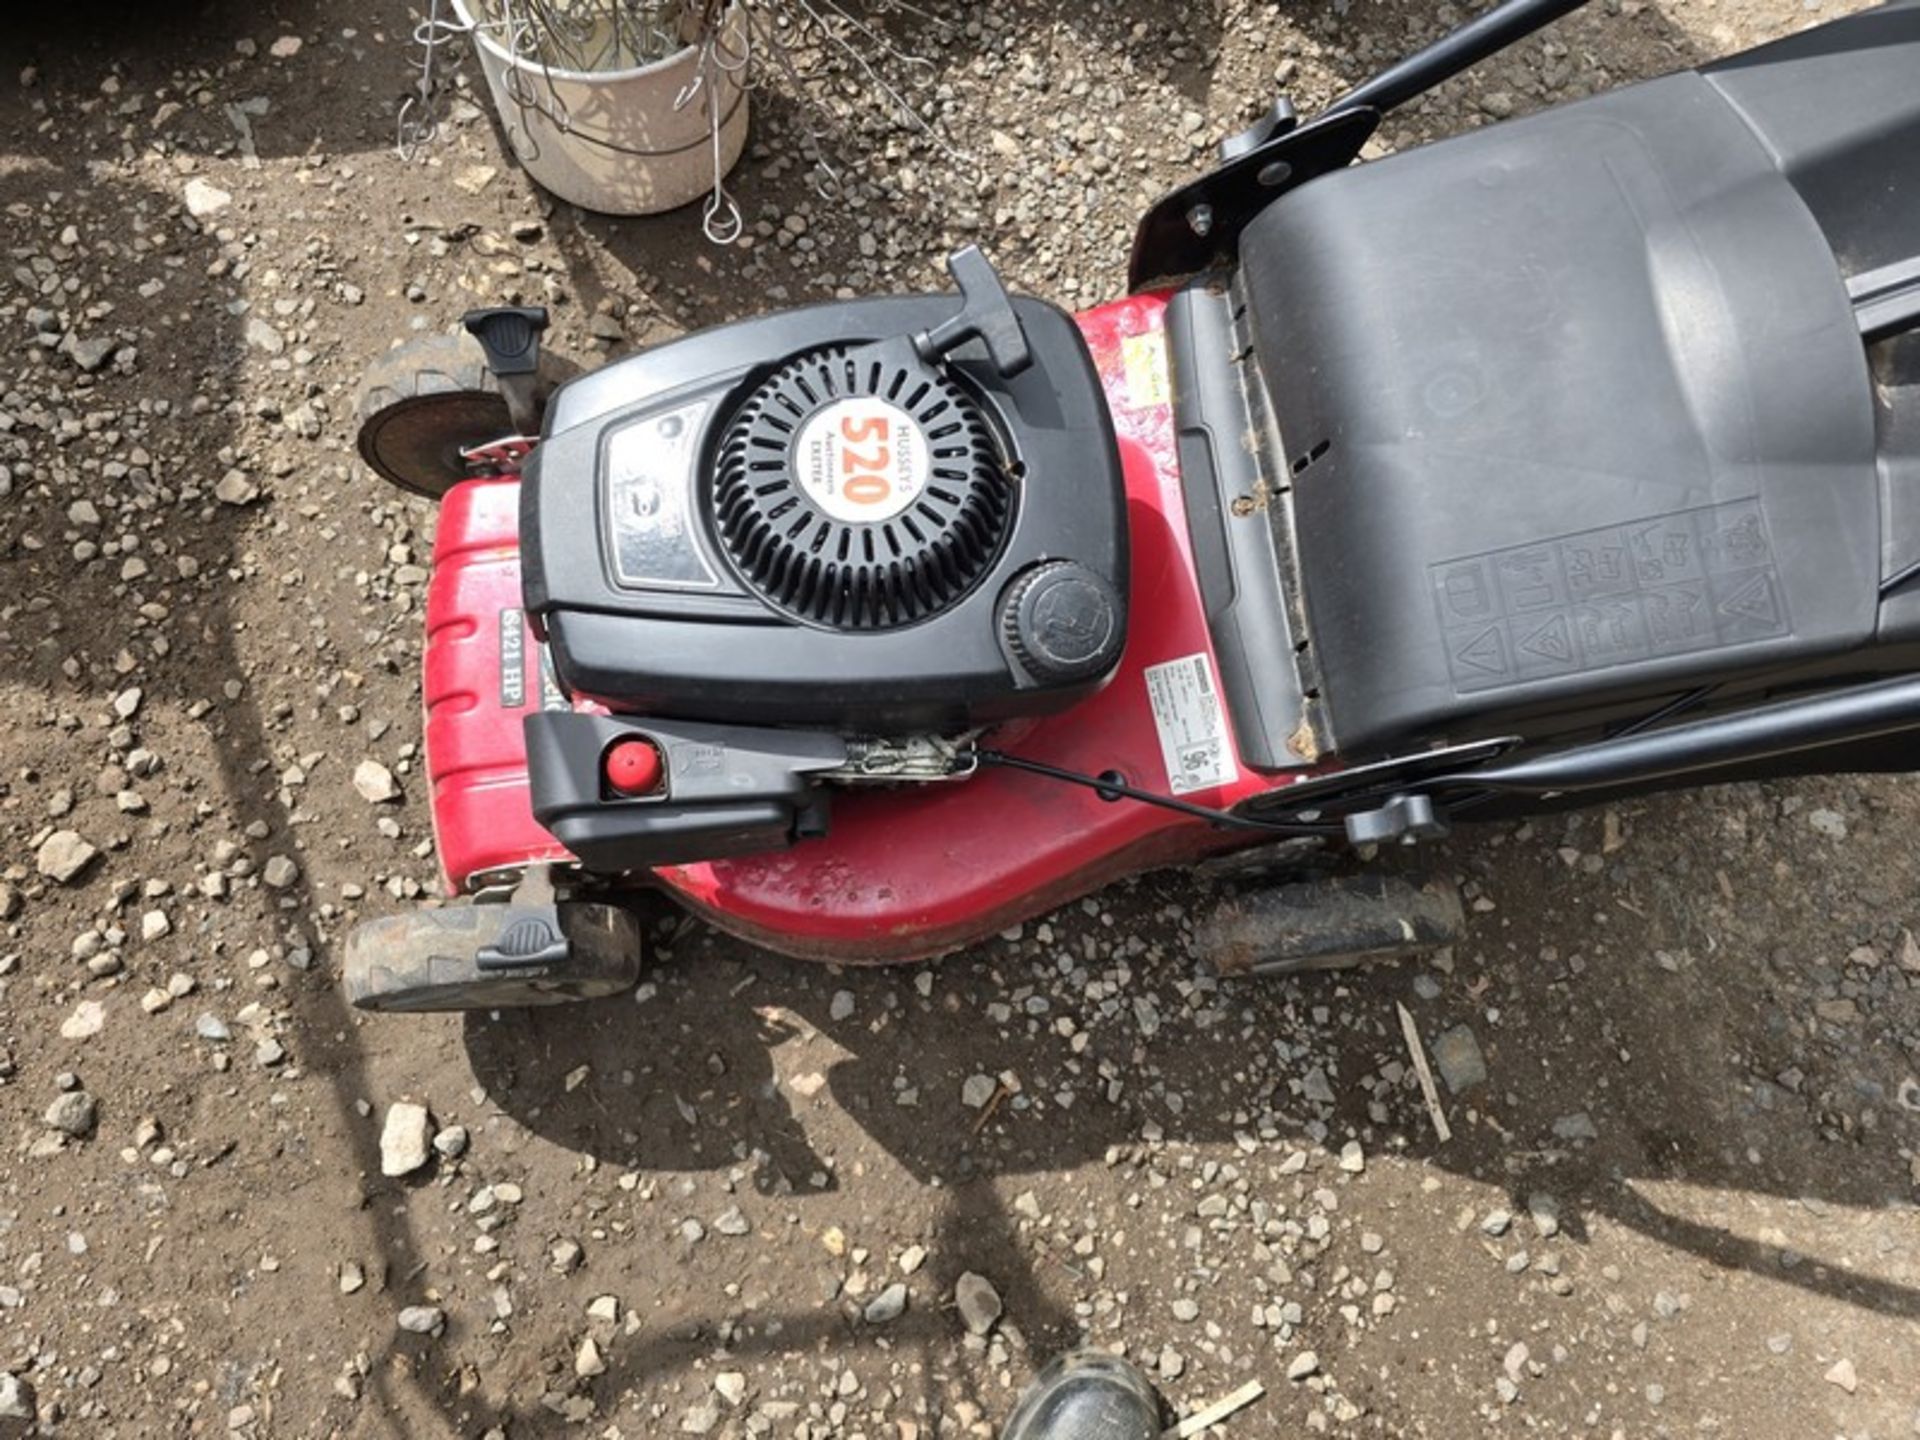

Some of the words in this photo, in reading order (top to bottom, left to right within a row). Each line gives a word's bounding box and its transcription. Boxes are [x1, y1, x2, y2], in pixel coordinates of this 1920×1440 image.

[810, 440, 822, 483] EXETER
[842, 416, 891, 505] 520
[897, 425, 913, 493] HUSSEYS
[503, 668, 521, 700] HP
